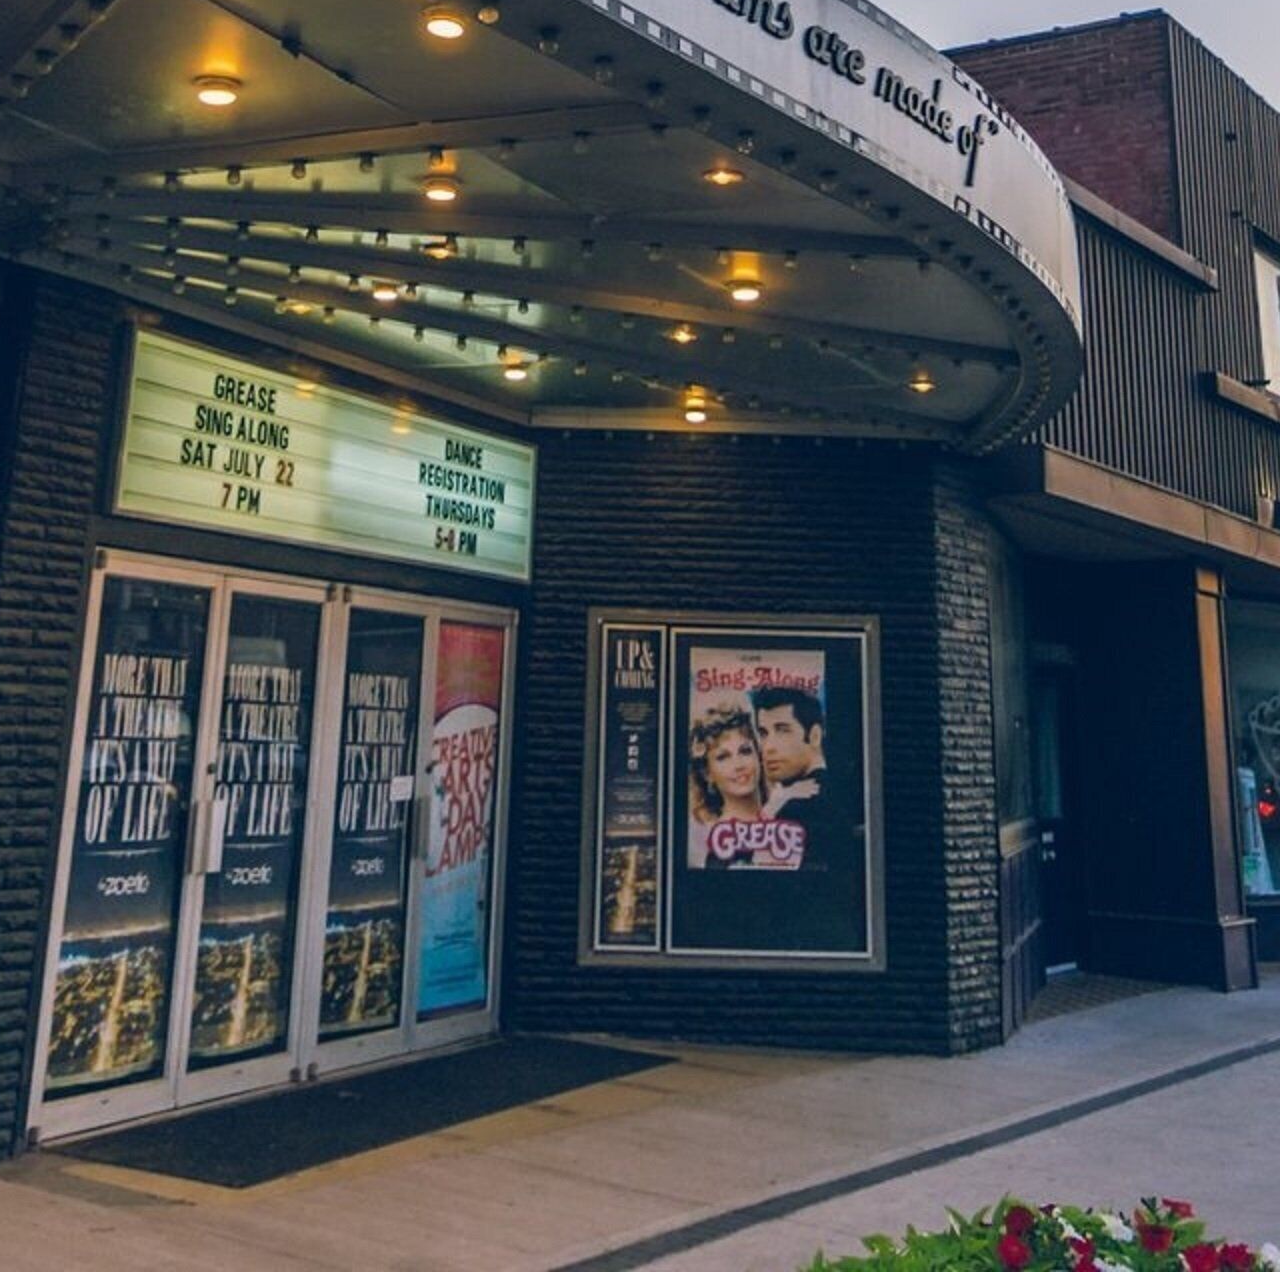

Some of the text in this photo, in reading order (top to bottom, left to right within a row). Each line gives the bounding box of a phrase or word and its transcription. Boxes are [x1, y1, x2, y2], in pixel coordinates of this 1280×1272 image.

[803, 25, 866, 85] are
[873, 66, 954, 143] made
[214, 373, 277, 414] GREASE
[195, 404, 289, 450] SING ALONG
[180, 438, 295, 488] SAT JULY 22
[445, 439, 483, 470] DANCE
[221, 482, 261, 514] 7 PM
[419, 462, 505, 504] REGISTRATION
[426, 494, 495, 530] THURSDAYS
[458, 531, 477, 556] PM
[84, 783, 174, 844] OF LIFE
[247, 783, 293, 837] LIFE
[710, 822, 804, 860] GREASE
